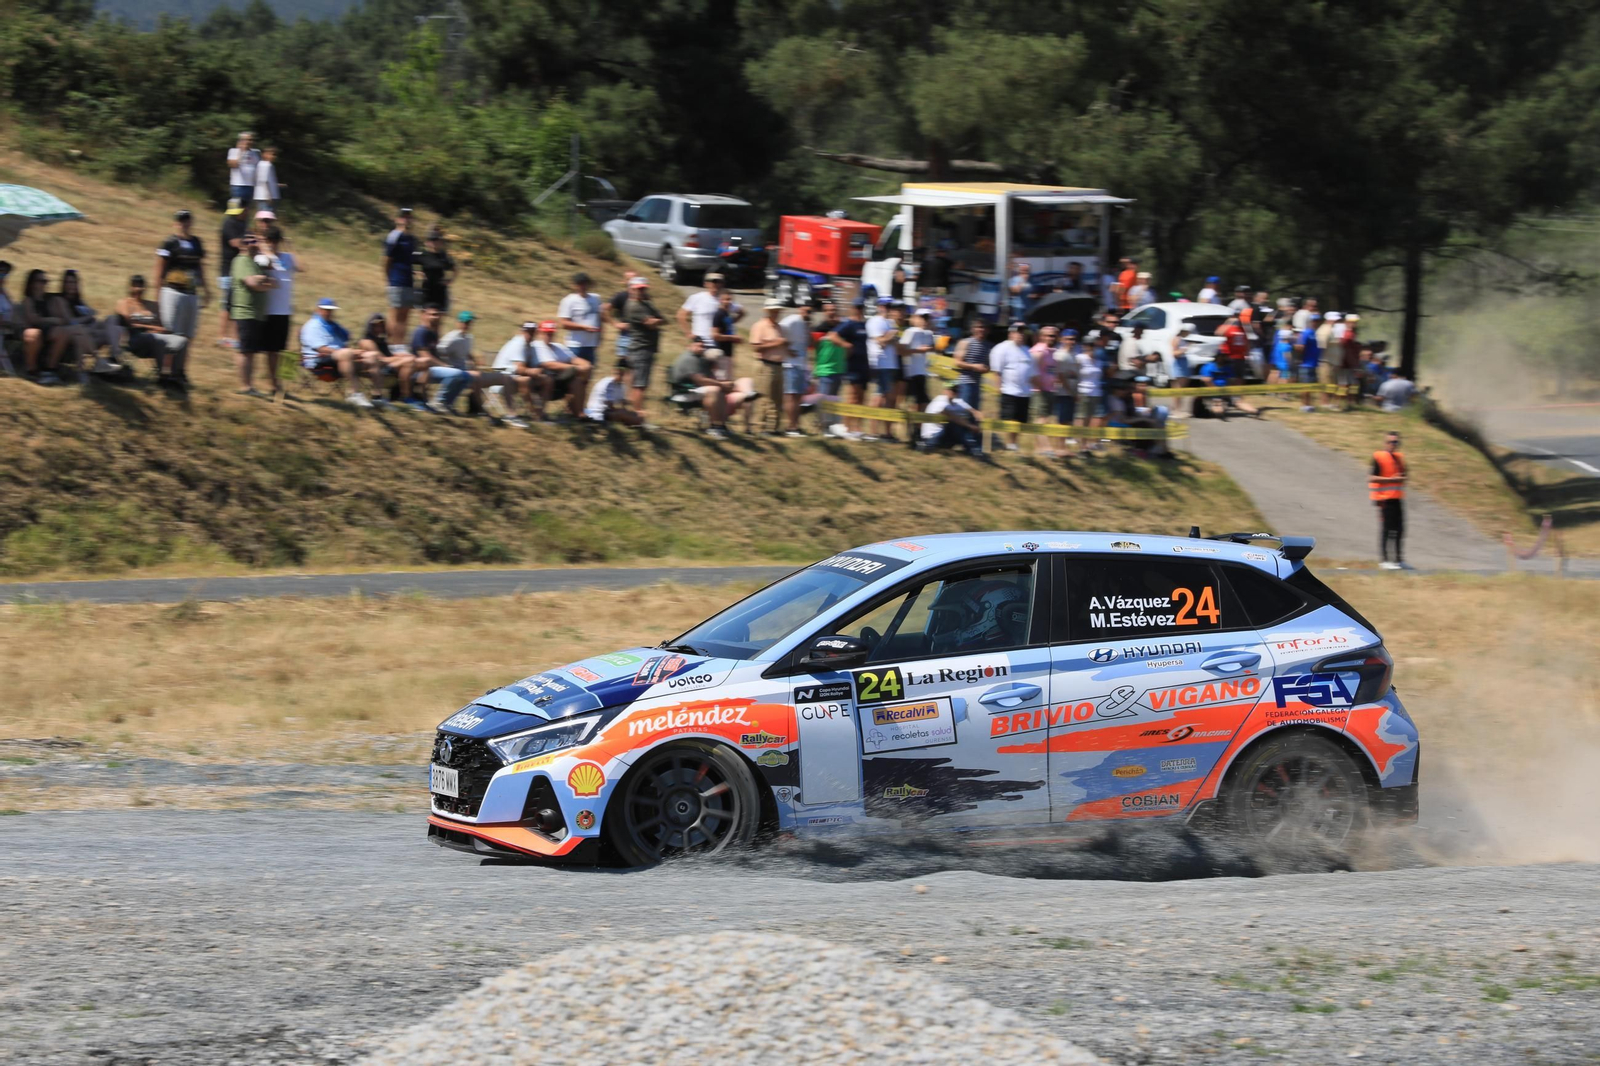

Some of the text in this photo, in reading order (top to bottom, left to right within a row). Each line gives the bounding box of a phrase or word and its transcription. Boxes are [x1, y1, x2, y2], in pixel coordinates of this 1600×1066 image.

[1089, 595, 1171, 611] A.Vázquez
[1171, 586, 1220, 626] 24
[1090, 611, 1176, 628] M.Estévez
[1123, 642, 1202, 659] HYUNDAI
[1147, 660, 1183, 669] Hyupersa
[858, 670, 901, 700] 24
[907, 672, 934, 686] La
[1273, 672, 1355, 709] FGA
[990, 669, 1261, 737] BRIVIO & VIGANÒ
[886, 706, 925, 720] Recalvi
[1315, 708, 1346, 716] GALEGA
[629, 706, 751, 736] meléndez
[890, 724, 920, 732] HOSPITAL
[1280, 716, 1347, 726] AUTOMOBILISMO
[673, 726, 708, 734] PATATAS
[891, 726, 952, 741] recoletas salud
[925, 736, 952, 744] OURENSE
[886, 786, 928, 798] Rallycar
[1122, 794, 1179, 808] COBIAN
